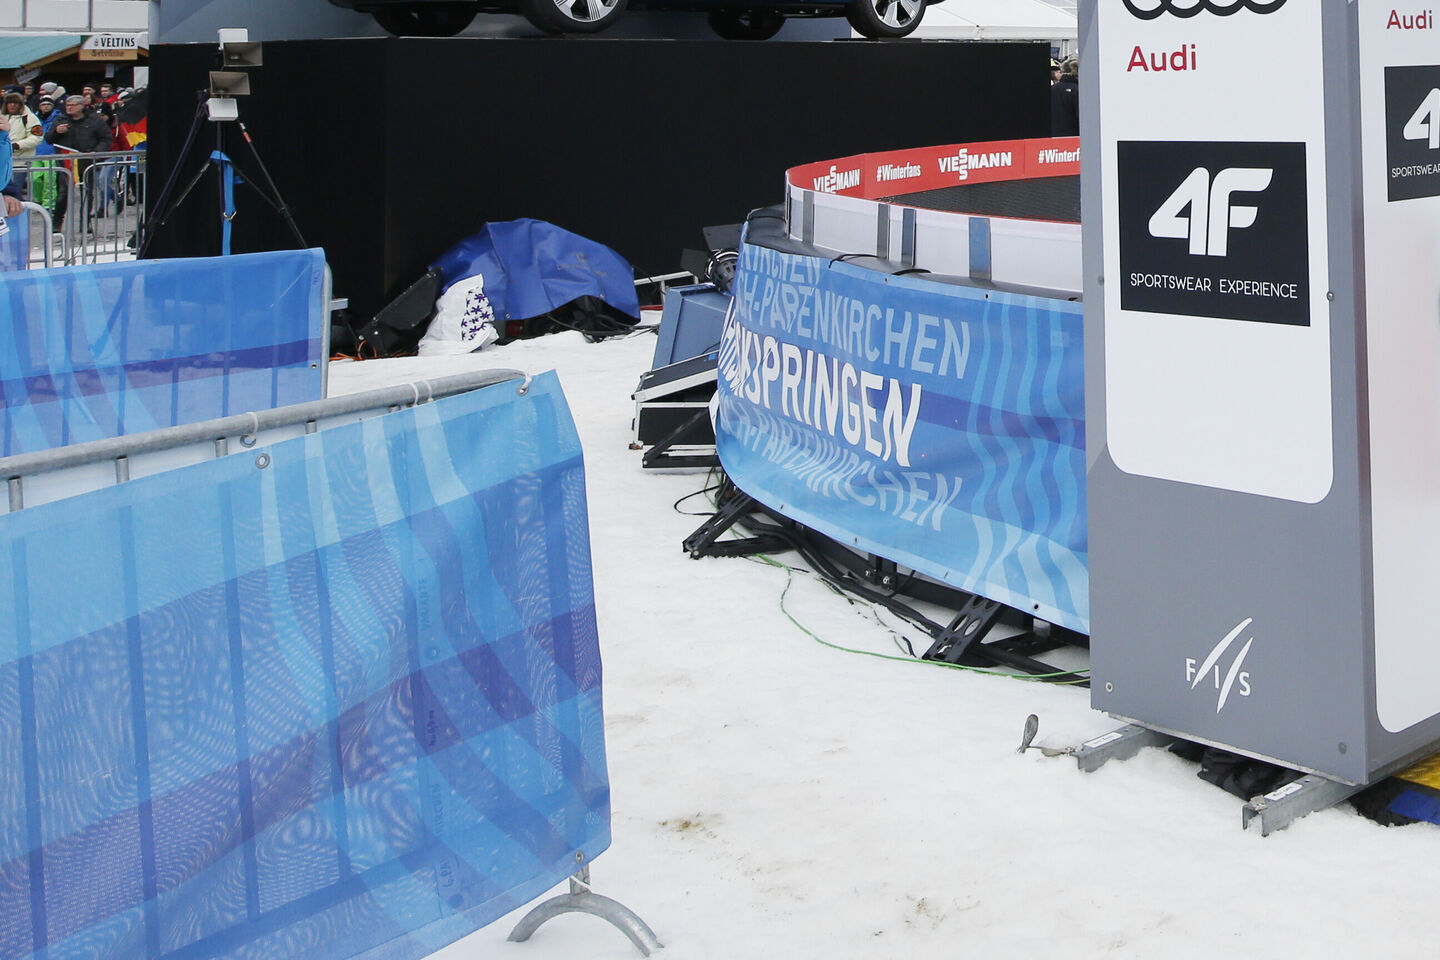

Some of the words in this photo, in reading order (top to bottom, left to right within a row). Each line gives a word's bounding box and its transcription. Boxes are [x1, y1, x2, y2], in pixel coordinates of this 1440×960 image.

[1386, 9, 1434, 30] Audi
[100, 37, 135, 48] VELTINS
[1127, 43, 1198, 73] Audi
[813, 165, 861, 193] VIESMANN
[876, 162, 921, 182] #Winterfans
[938, 148, 1012, 180] VIESSMANN
[1037, 147, 1081, 164] #Winterf
[1148, 166, 1273, 257] 4F
[1130, 272, 1212, 293] SPORTSWEAR
[1219, 278, 1298, 300] EXPERIENCE
